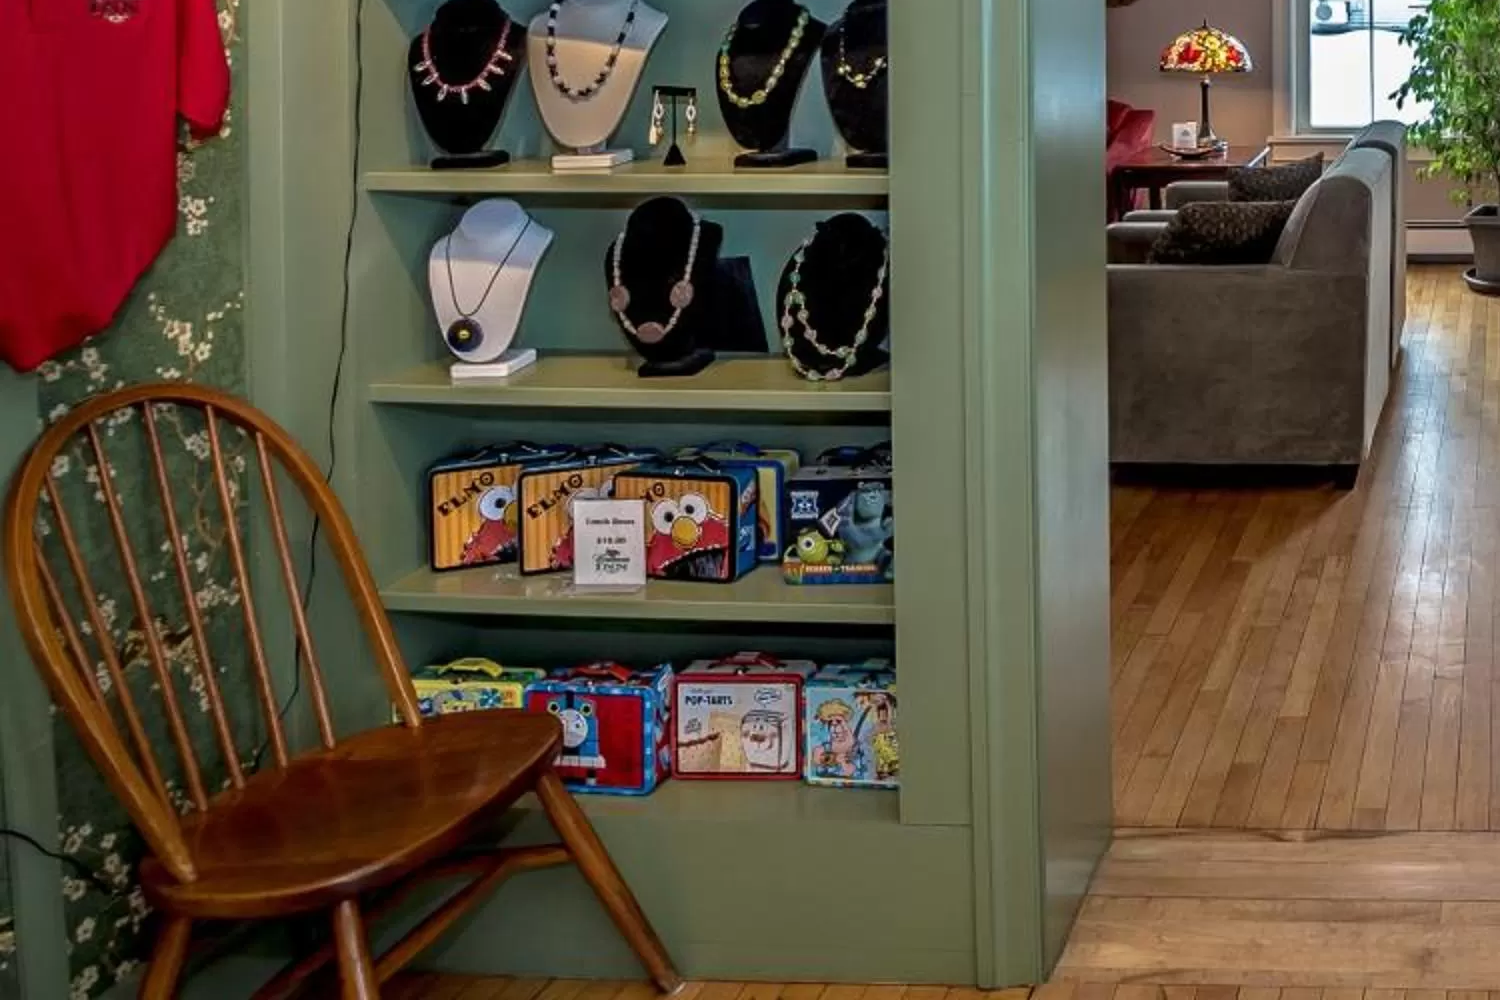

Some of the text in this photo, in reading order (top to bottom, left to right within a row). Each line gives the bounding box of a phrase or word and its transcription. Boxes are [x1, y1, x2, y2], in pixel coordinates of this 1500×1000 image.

[437, 471, 495, 517] ELMO
[526, 473, 584, 520] ELMO
[684, 694, 734, 706] POP-TARTS
